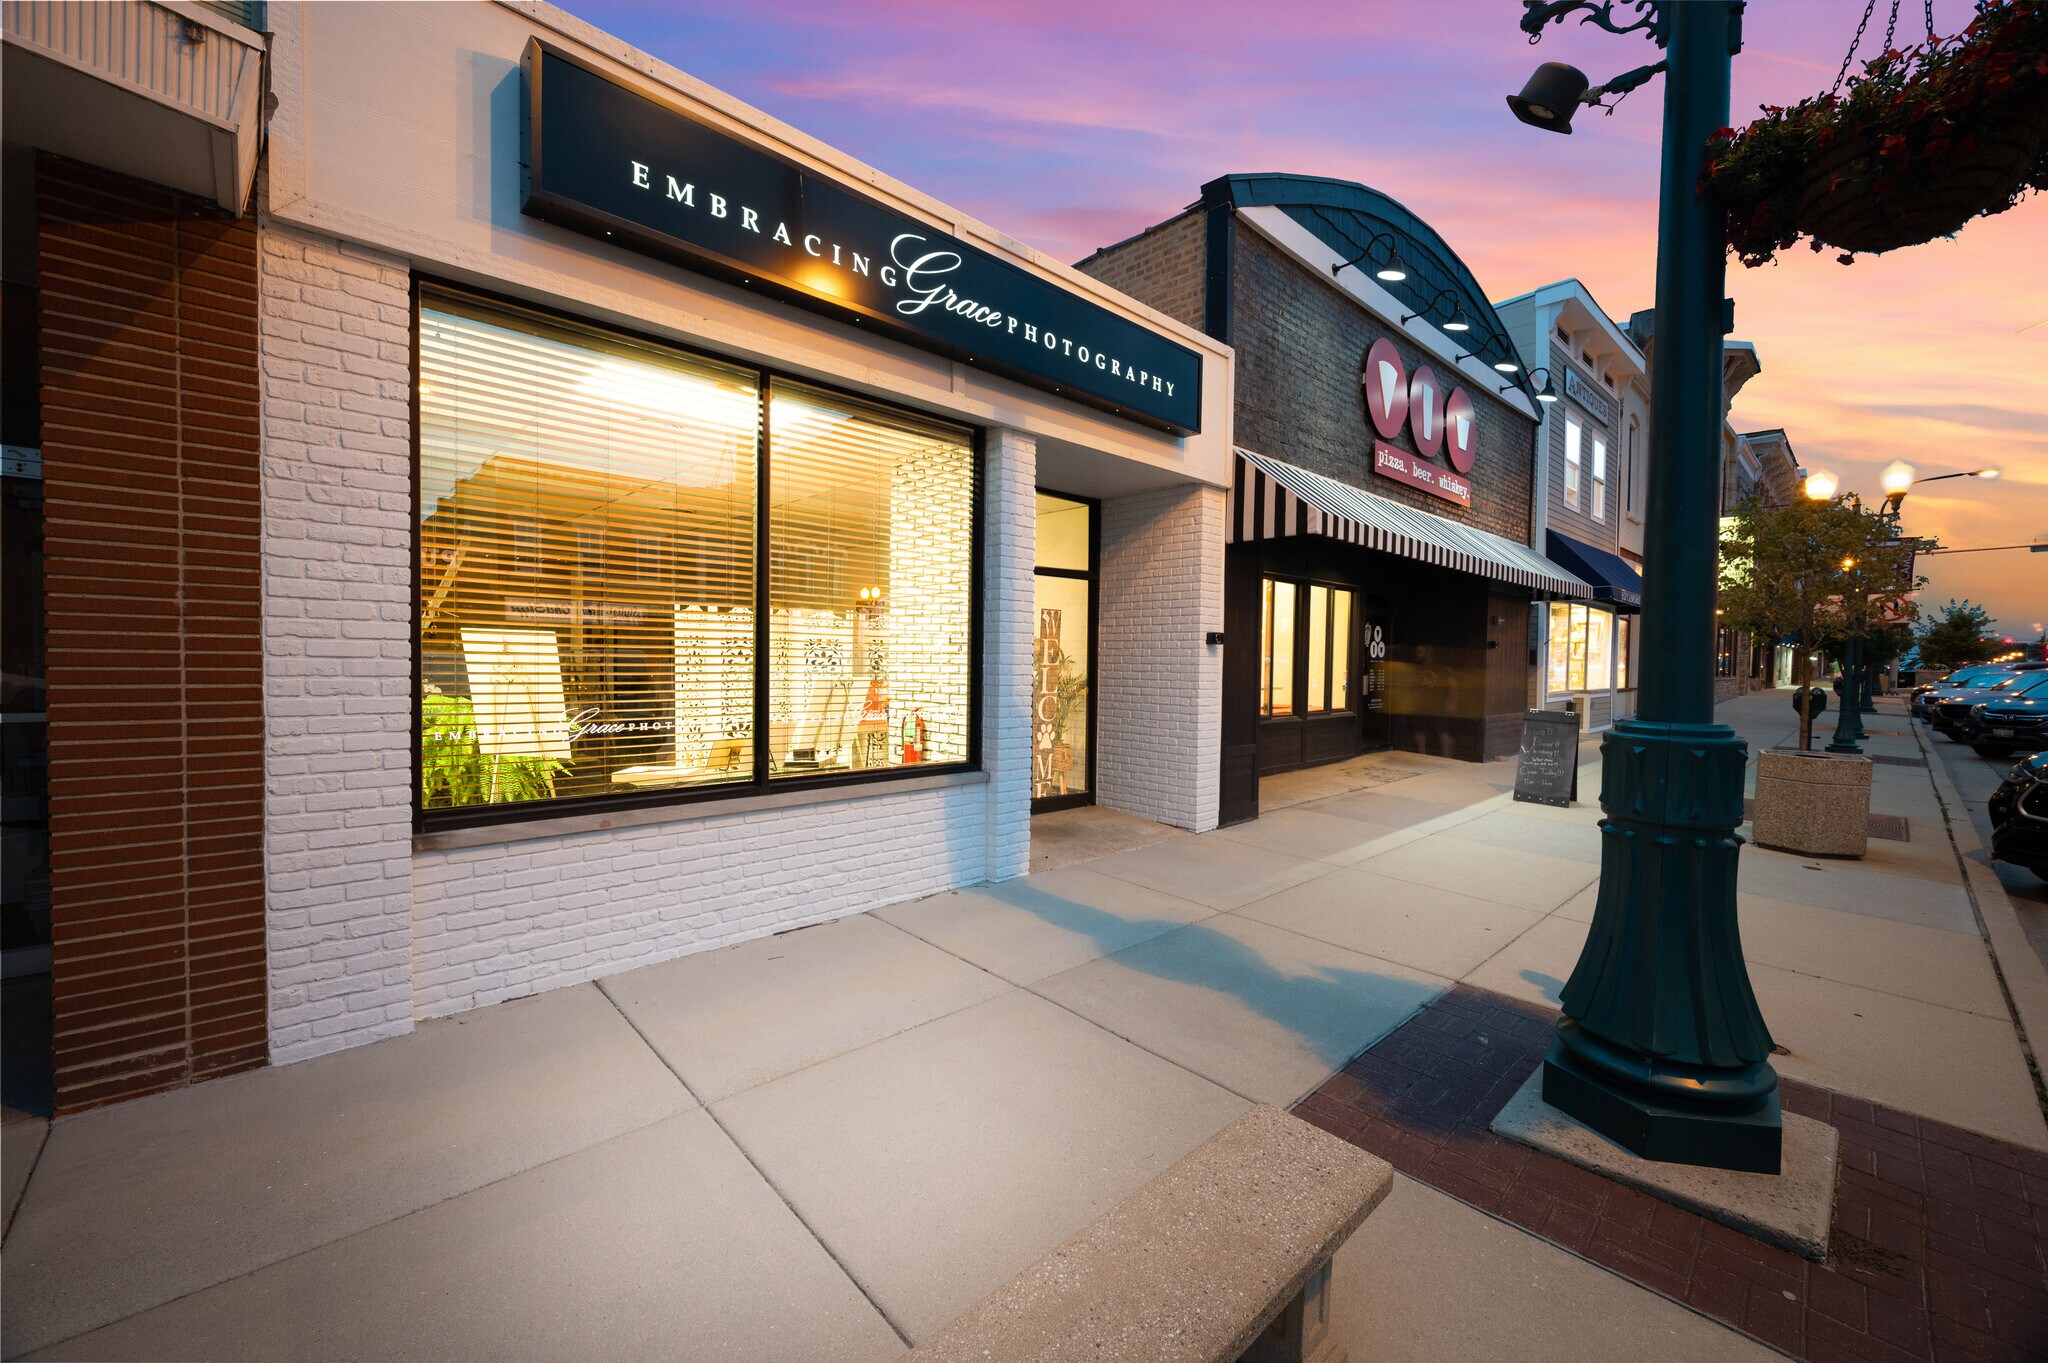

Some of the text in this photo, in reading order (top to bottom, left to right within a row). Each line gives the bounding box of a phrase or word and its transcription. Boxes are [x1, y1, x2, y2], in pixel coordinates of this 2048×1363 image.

[631, 160, 1175, 397] EMBRACING Grace PHOTOGRAPHY
[1568, 375, 1607, 418] ANTIQUES
[1378, 450, 1470, 500] pizza. beer. whiskey.
[559, 707, 627, 743] Grace
